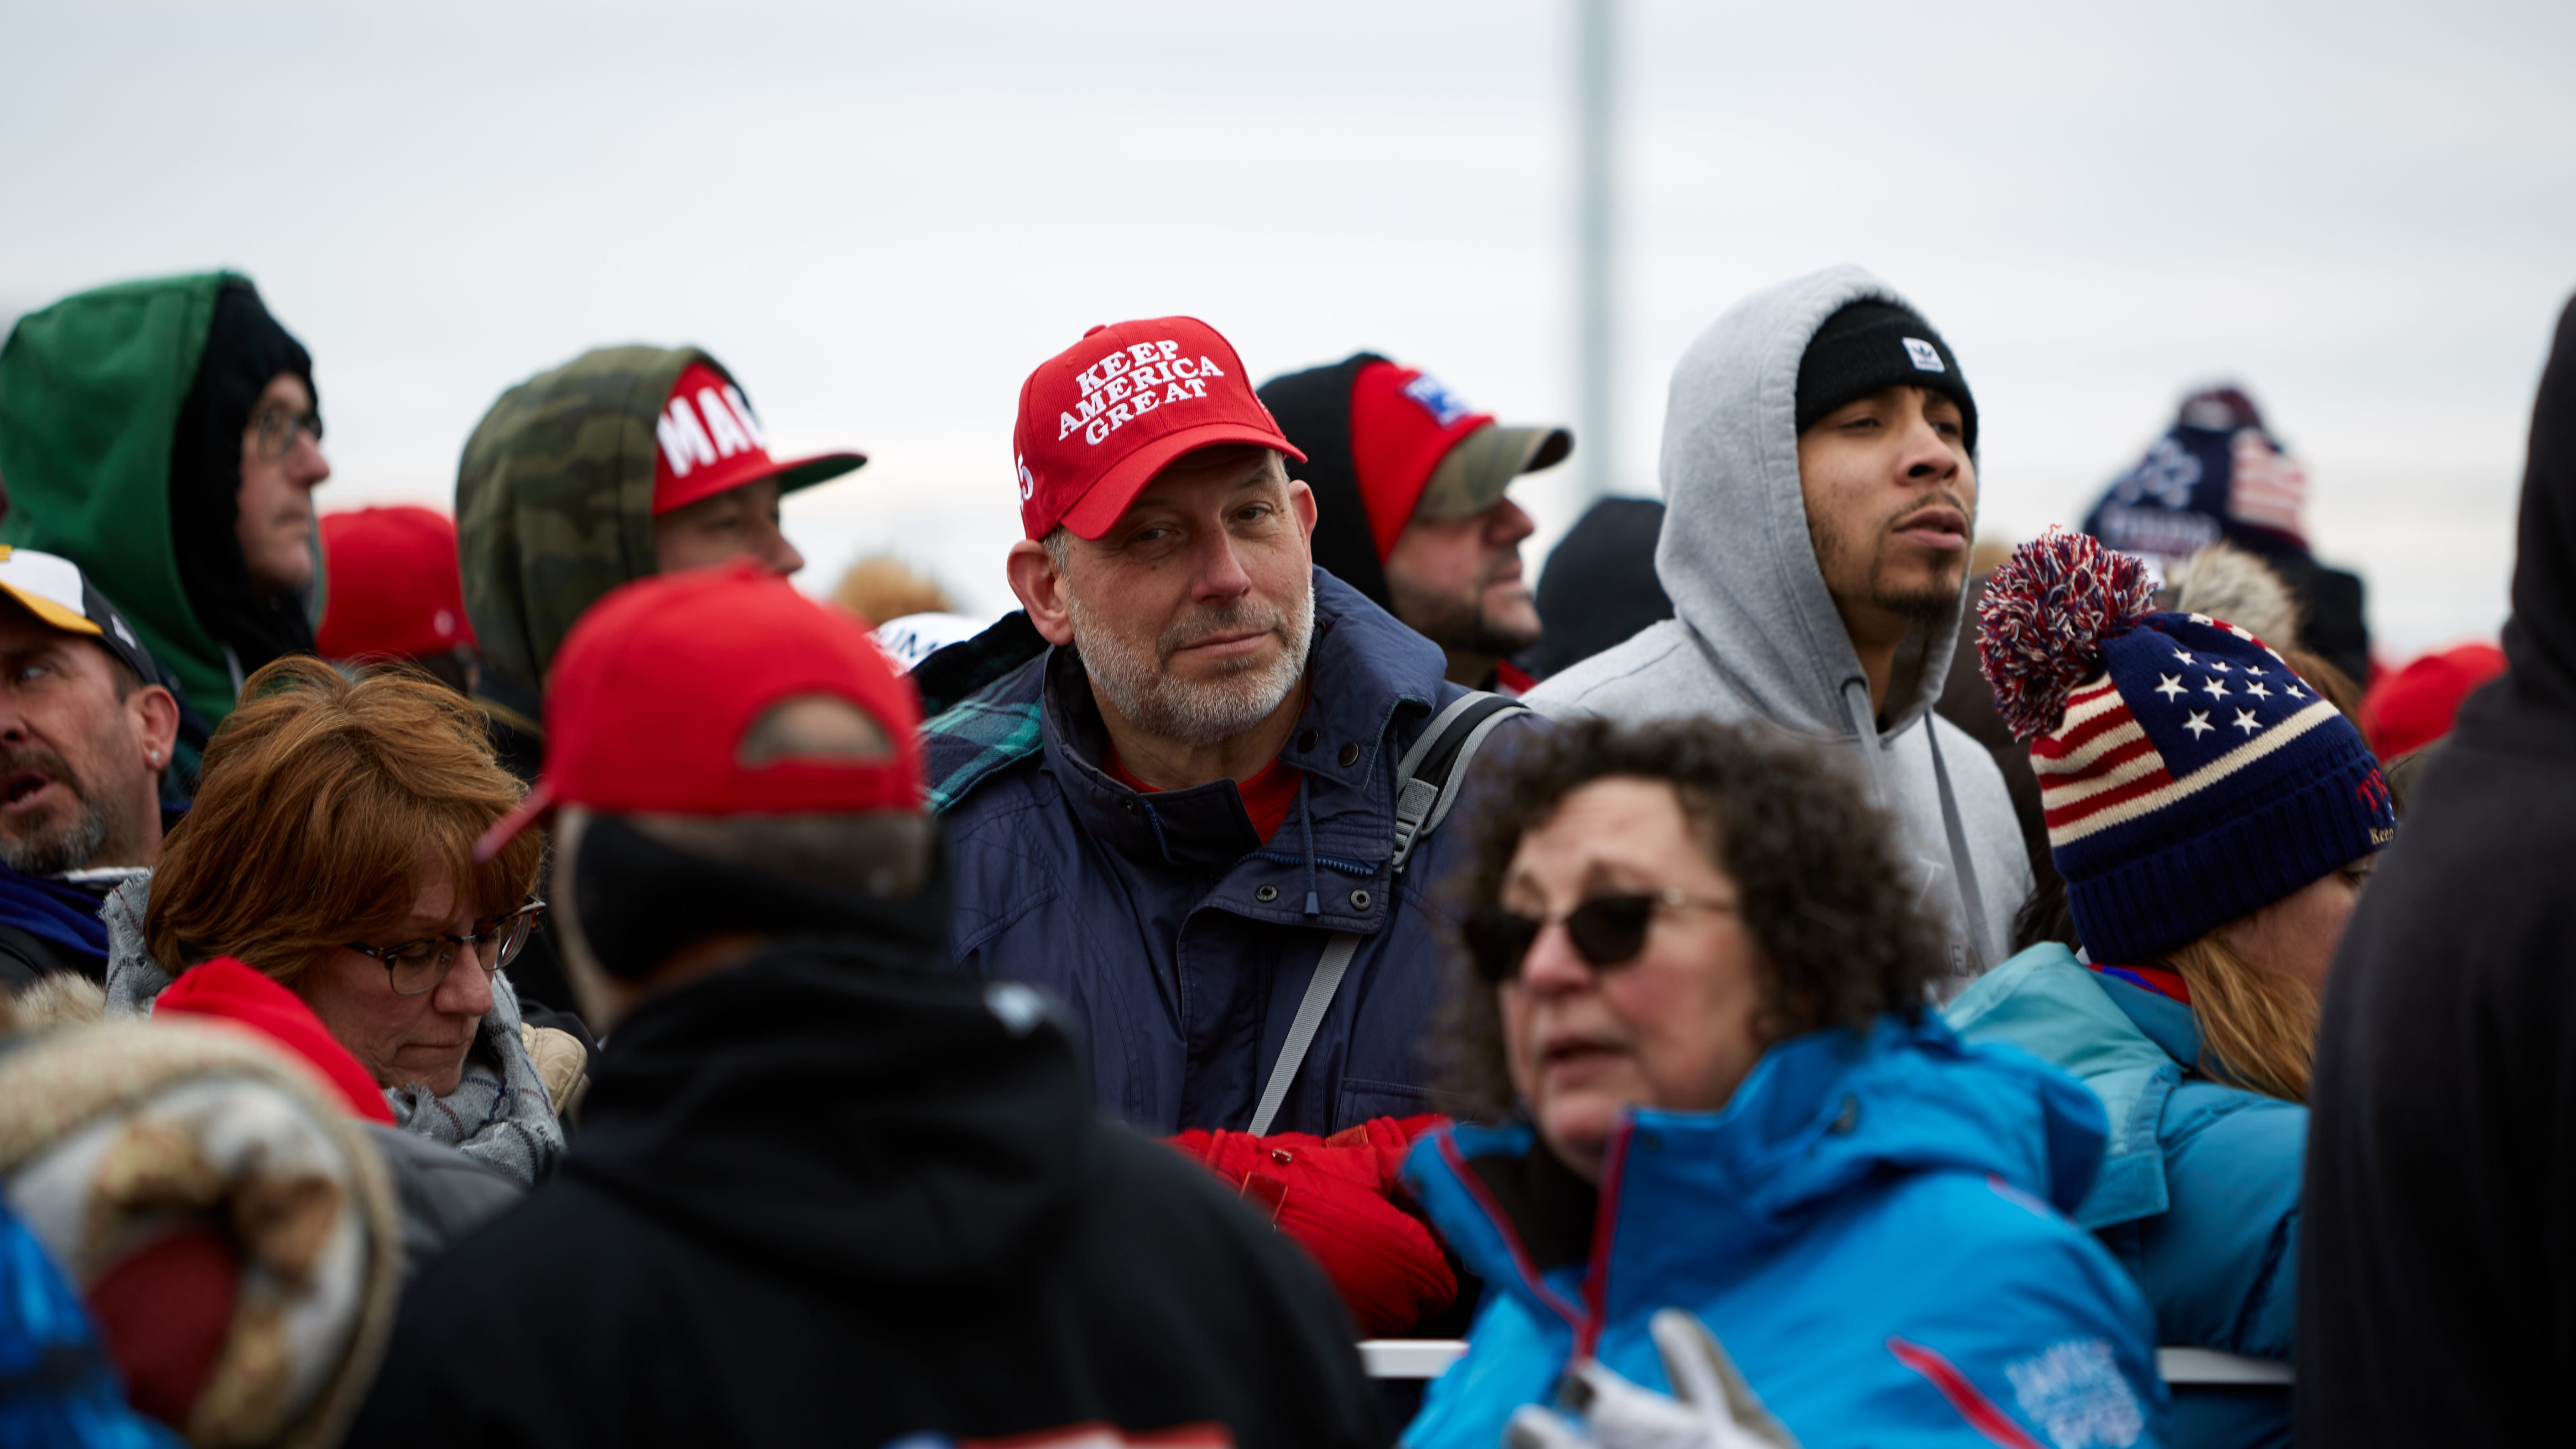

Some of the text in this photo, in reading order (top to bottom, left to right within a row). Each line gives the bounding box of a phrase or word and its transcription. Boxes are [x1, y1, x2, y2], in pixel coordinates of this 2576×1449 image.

[1058, 356, 1224, 441] AMERICA
[1076, 339, 1178, 397] KEEP
[1086, 378, 1207, 445] GREAT
[2369, 827, 2394, 844] Keep
